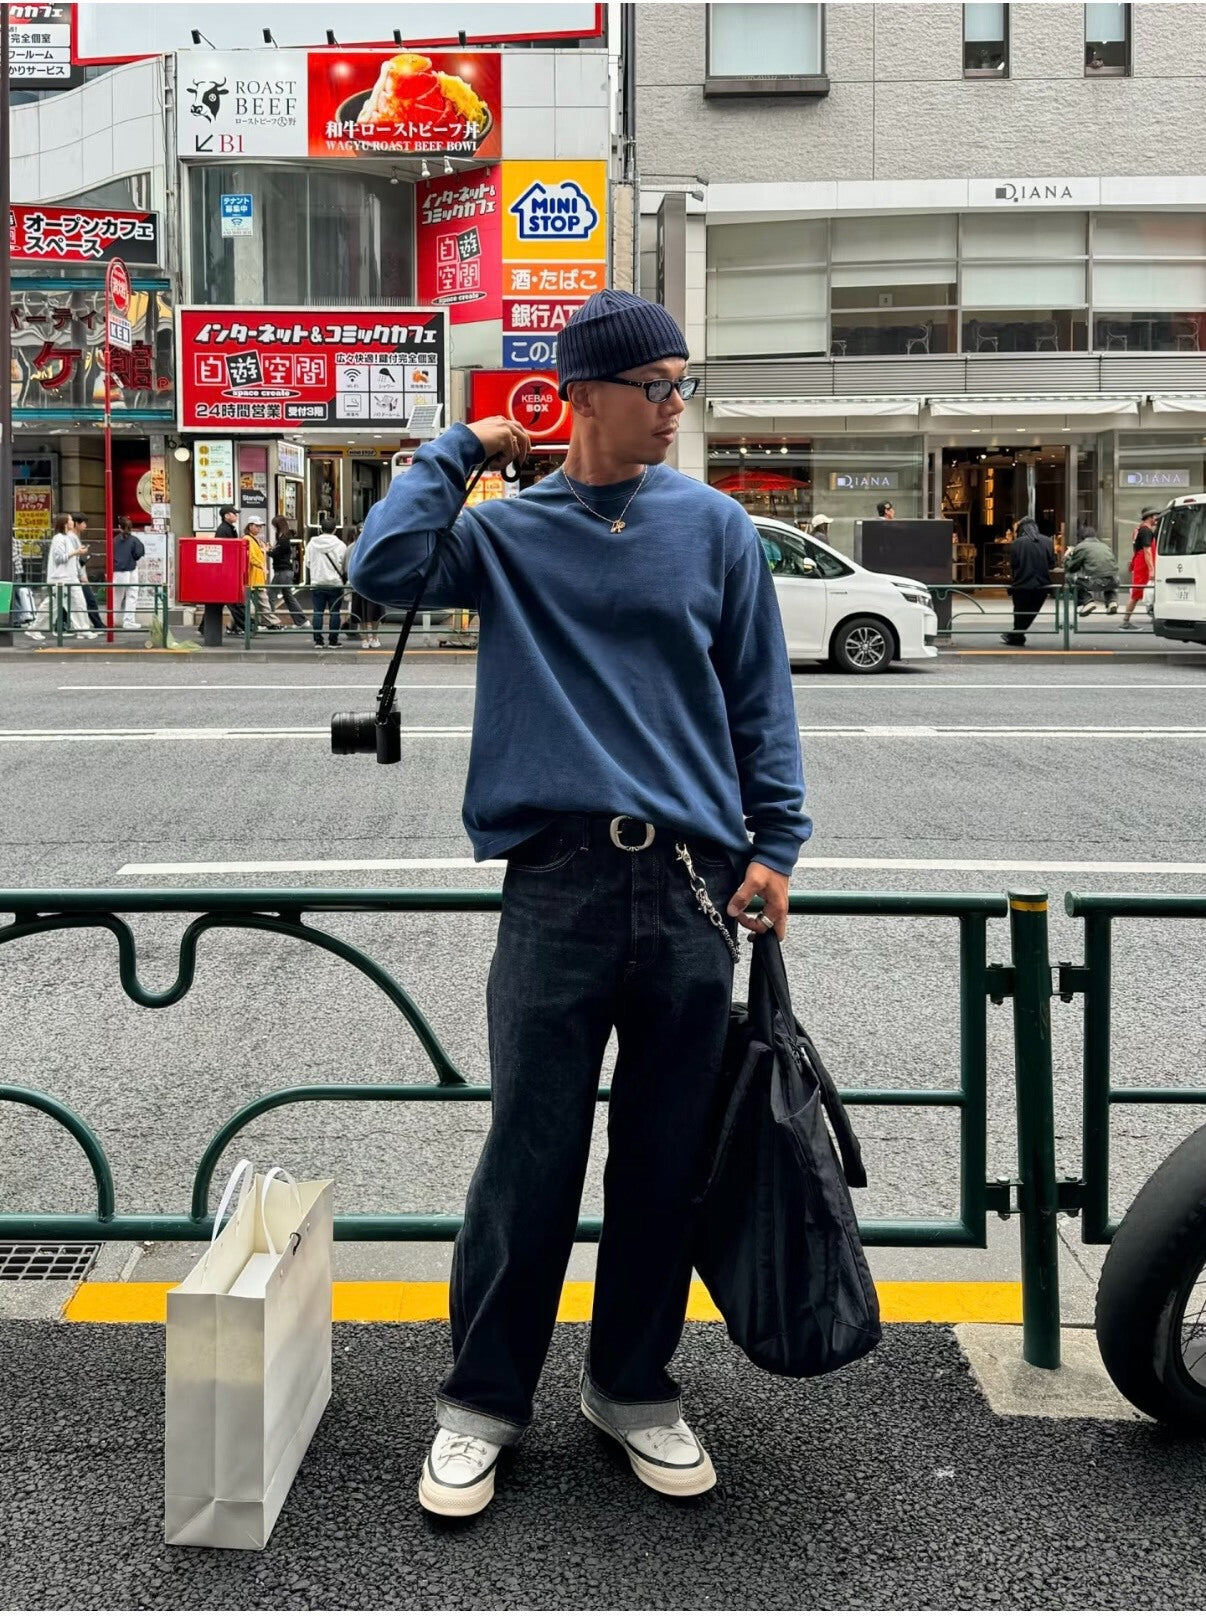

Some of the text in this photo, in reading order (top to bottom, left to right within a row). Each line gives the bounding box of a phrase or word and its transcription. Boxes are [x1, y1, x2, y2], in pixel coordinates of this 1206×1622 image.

[236, 80, 297, 94] ROAST
[235, 97, 297, 115] BEEF
[325, 120, 480, 139] 和牛ローストビーフ丼
[219, 134, 244, 153] B1
[326, 141, 478, 151] WAGYU ROAST BEEF BOWL
[995, 183, 1072, 203] DIANA
[421, 200, 496, 225] コミックカフェ
[531, 197, 577, 214] MINI
[25, 213, 154, 240] オープンカフェ
[529, 215, 580, 232] STOP
[25, 234, 103, 257] スペース
[511, 268, 598, 290] 酒・たばこ
[511, 303, 582, 328] 銀行AT
[195, 323, 437, 344] インターネット&コミックカフェ
[511, 341, 557, 364] この
[197, 352, 326, 387] 自遊空間
[232, 389, 290, 398] space create
[521, 394, 553, 403] KEBAB
[196, 403, 281, 419] 24時間営業
[526, 404, 549, 413] BOX
[837, 474, 890, 489] DIANA
[1127, 472, 1181, 486] DIANA
